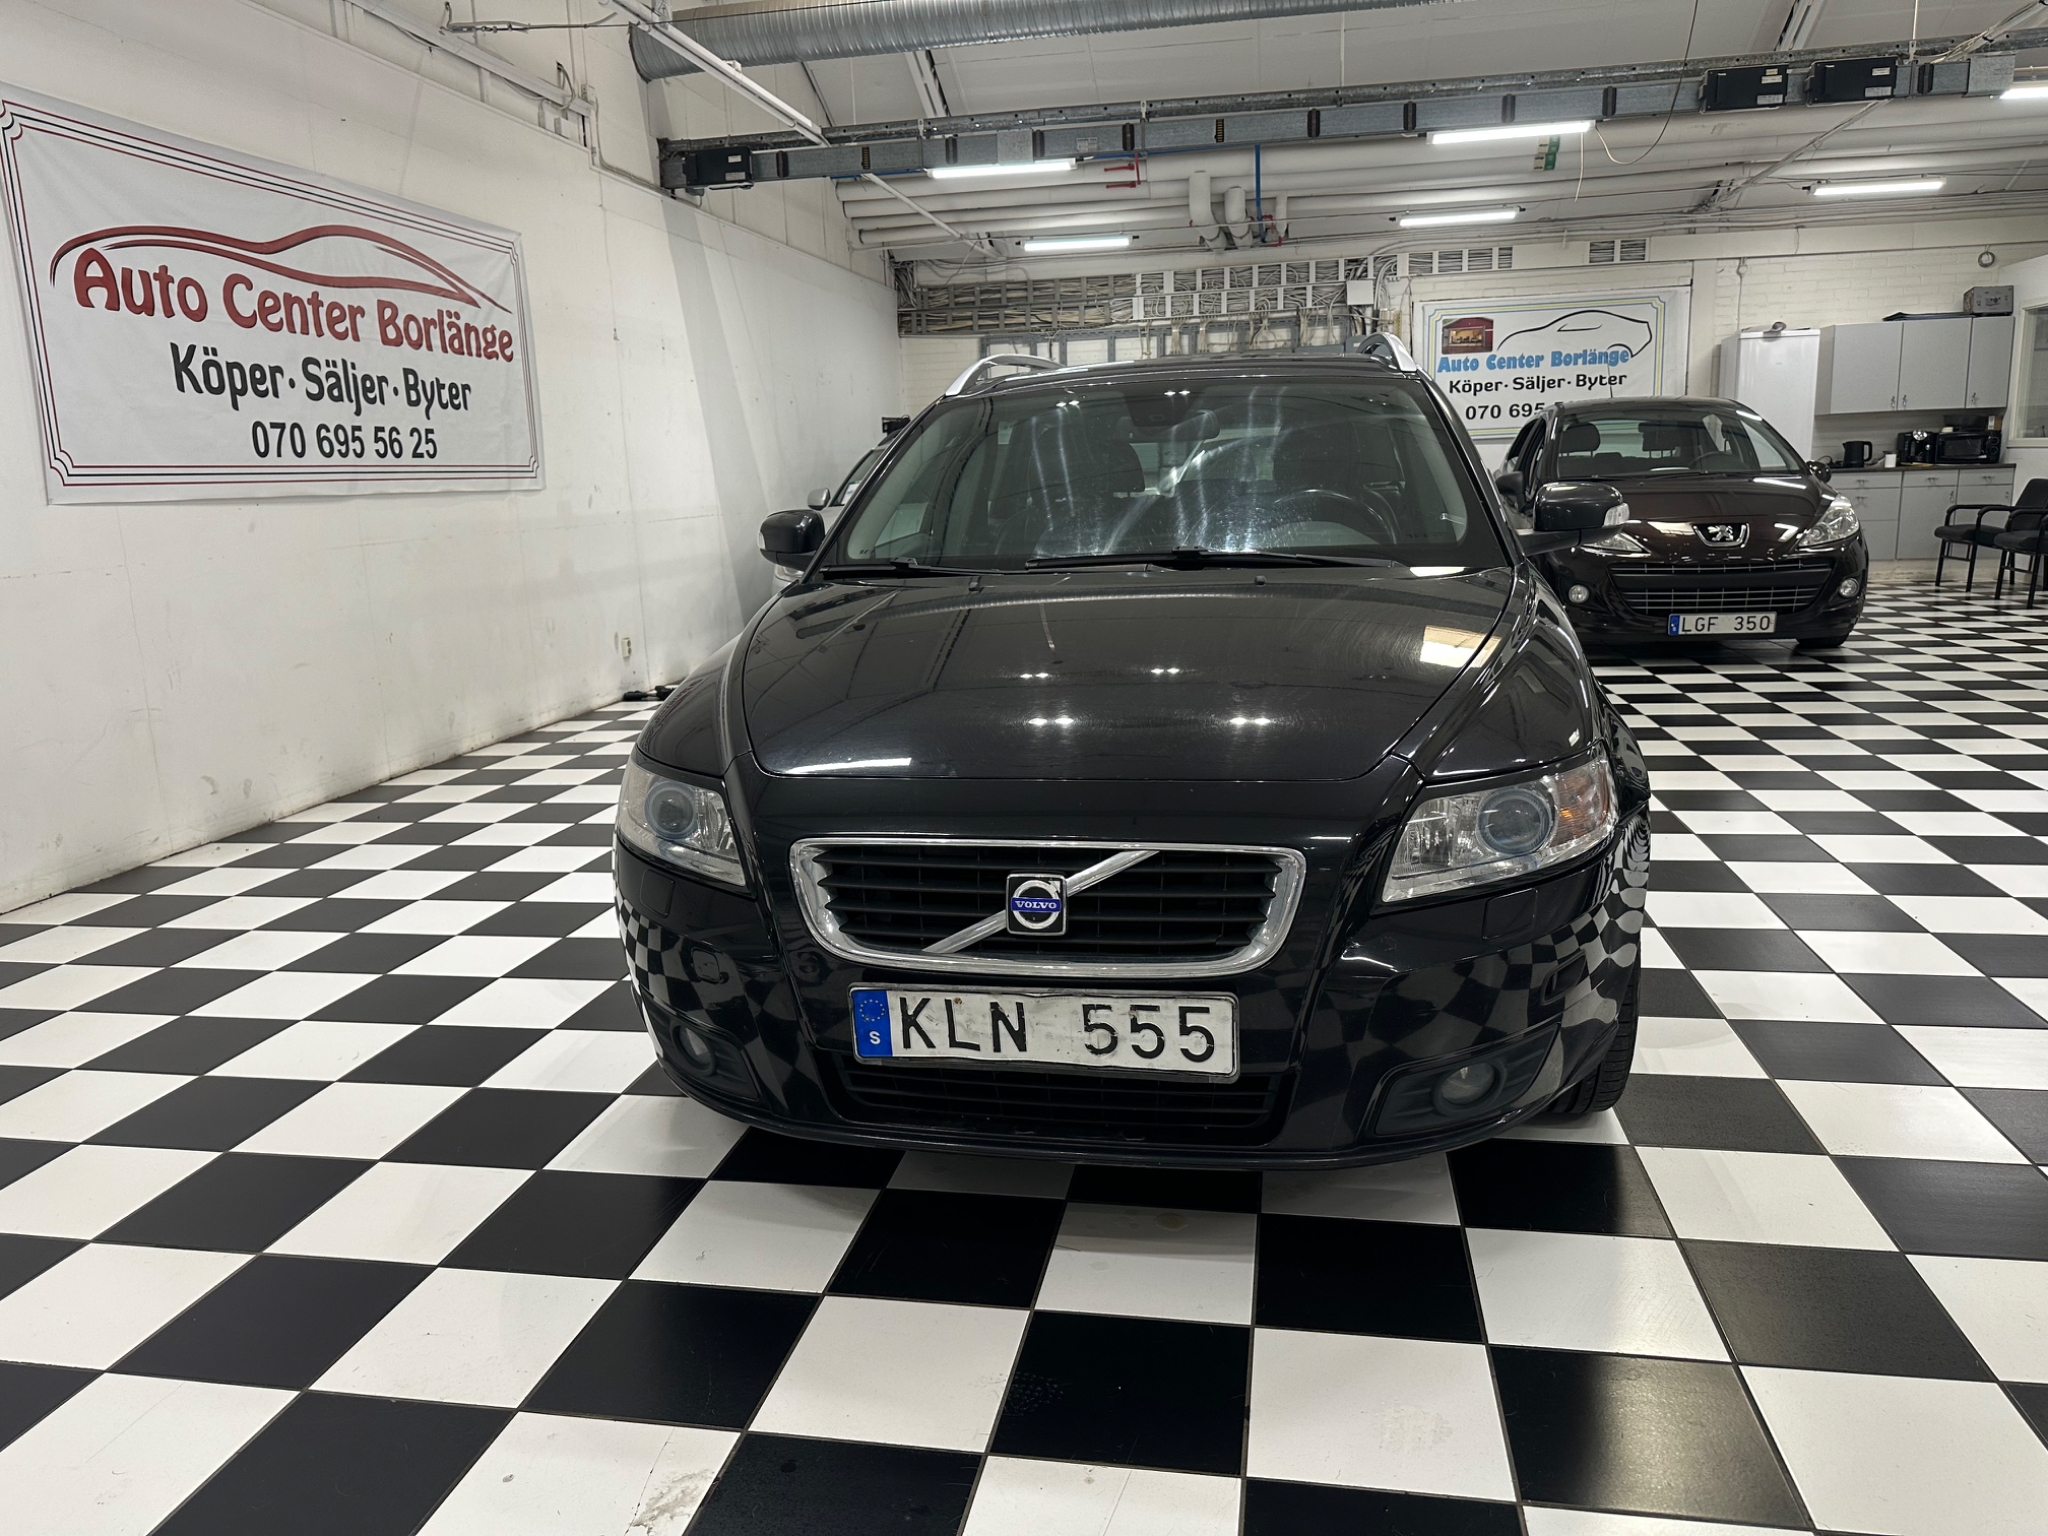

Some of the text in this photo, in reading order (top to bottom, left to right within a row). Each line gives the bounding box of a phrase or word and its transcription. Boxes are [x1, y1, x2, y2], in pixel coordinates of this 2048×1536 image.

[74, 248, 514, 362] Auto Center Borlänge
[1437, 348, 1630, 373] Auto Center Borlänge
[1575, 373, 1627, 390] Byter
[403, 368, 472, 420] Byter
[1465, 404, 1502, 420] 070
[251, 421, 438, 459] 070 695 56 25
[1681, 615, 1771, 632] LGF 350
[1014, 900, 1058, 909] VOLVO
[869, 1031, 881, 1045] S
[899, 997, 1215, 1063] KLN 555
